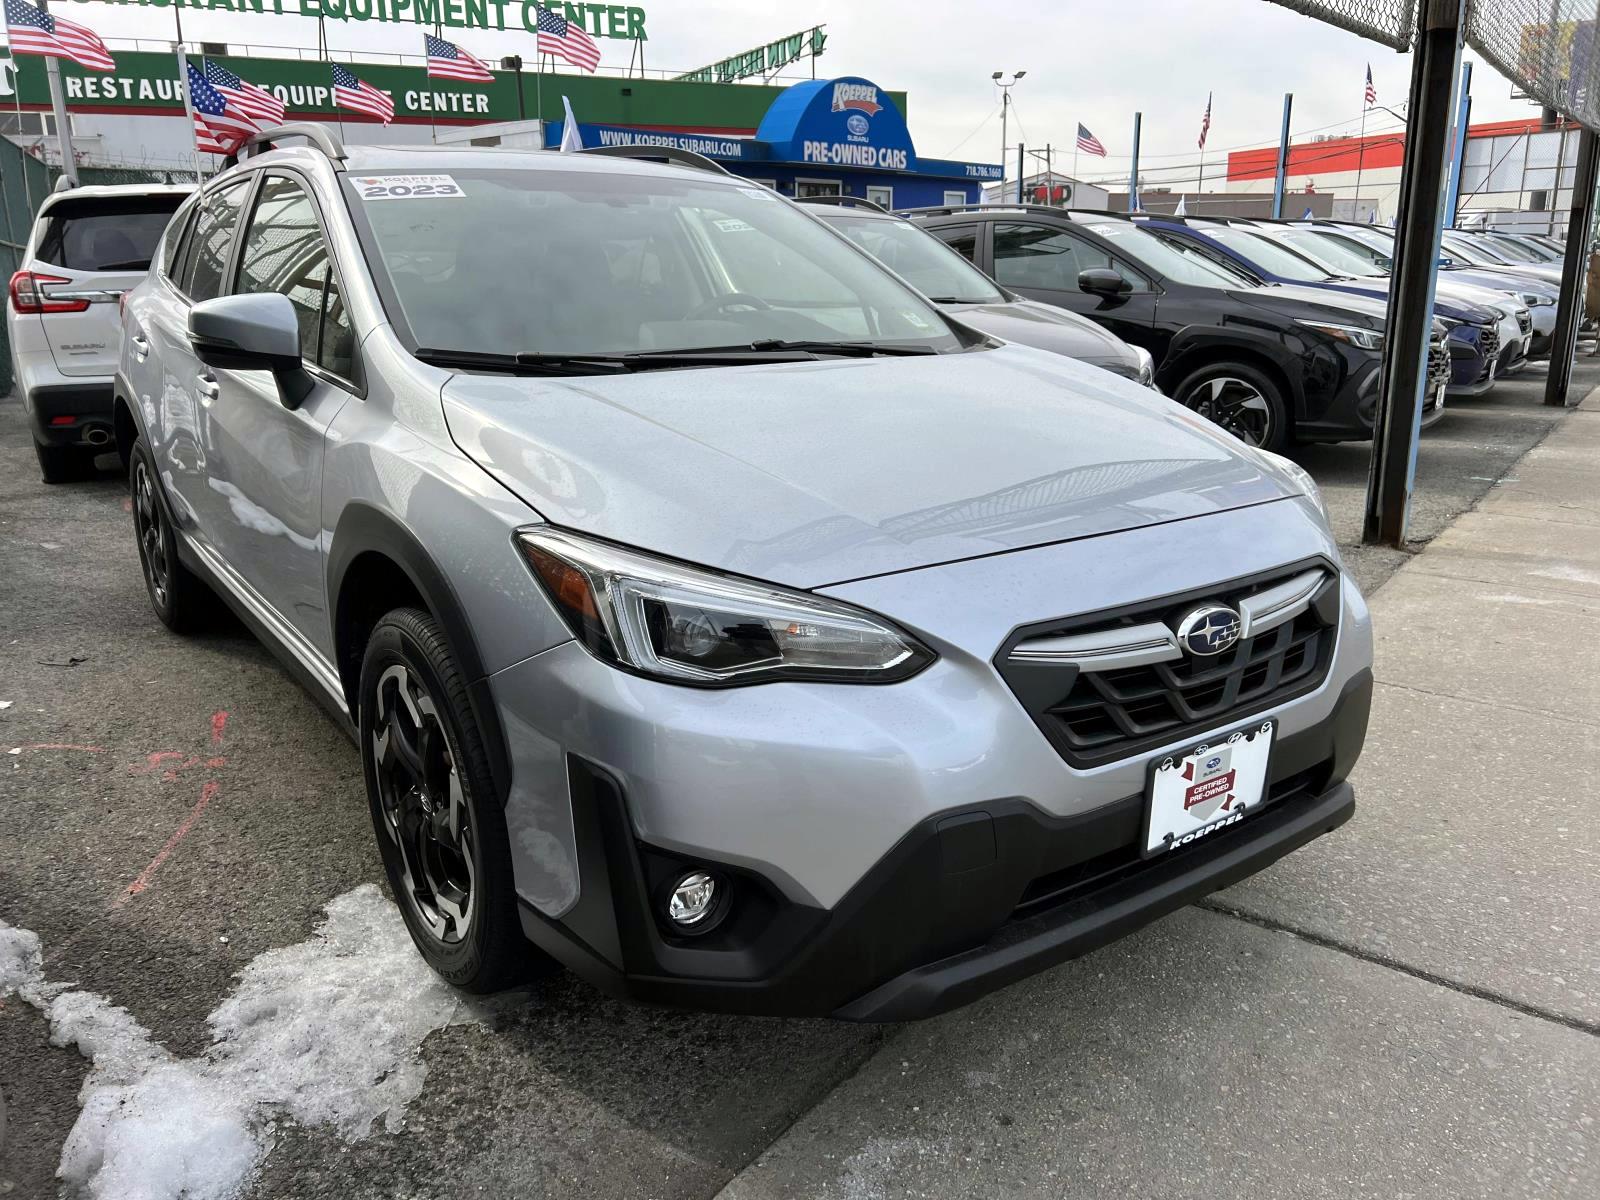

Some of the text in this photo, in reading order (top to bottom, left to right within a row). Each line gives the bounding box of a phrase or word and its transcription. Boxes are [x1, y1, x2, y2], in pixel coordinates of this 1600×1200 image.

[405, 90, 489, 113] CENTER
[832, 83, 878, 110] KOEPPEL
[803, 140, 907, 169] PRE-OWNED CARS
[965, 165, 1001, 178] 718.786.1660
[364, 185, 459, 197] 2023
[1189, 783, 1230, 804] PRE-OWNED
[1193, 777, 1228, 795] CERTIFIED
[1170, 813, 1243, 849] KOEPPEL
